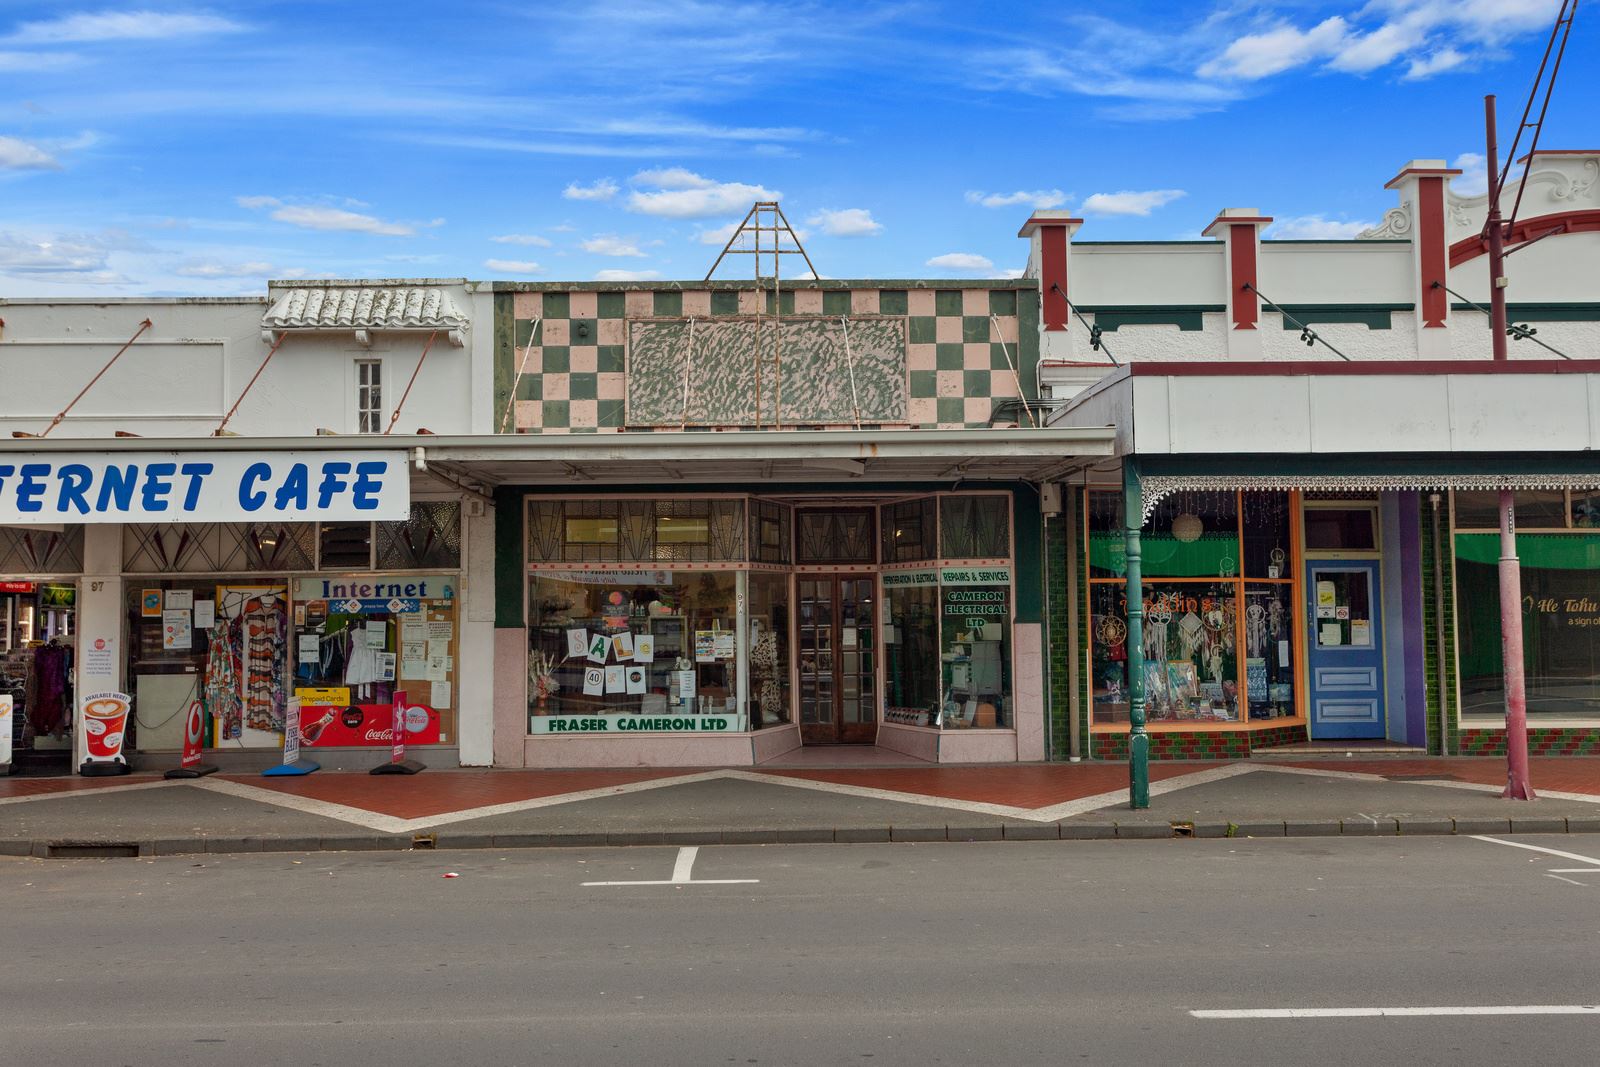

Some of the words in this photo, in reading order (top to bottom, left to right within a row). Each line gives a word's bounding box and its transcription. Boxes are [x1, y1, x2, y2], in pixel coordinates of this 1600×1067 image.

[238, 461, 388, 512] CAFE
[916, 573, 938, 583] ELECTRICAL
[943, 572, 970, 582] REPAIRS
[971, 572, 978, 582] &
[978, 571, 1009, 582] SERVICES
[91, 582, 104, 592] 97
[321, 580, 427, 598] Internet
[948, 591, 1005, 601] CAMERON
[945, 604, 1007, 615] ELECTRICAL
[1537, 598, 1560, 613] He
[965, 618, 985, 628] LTD
[1574, 617, 1592, 627] sign
[589, 674, 600, 683] 40
[85, 692, 111, 702] AVAILABLE
[548, 719, 608, 731] FRASER
[617, 718, 696, 731] CAMERON
[701, 718, 728, 730] LTD
